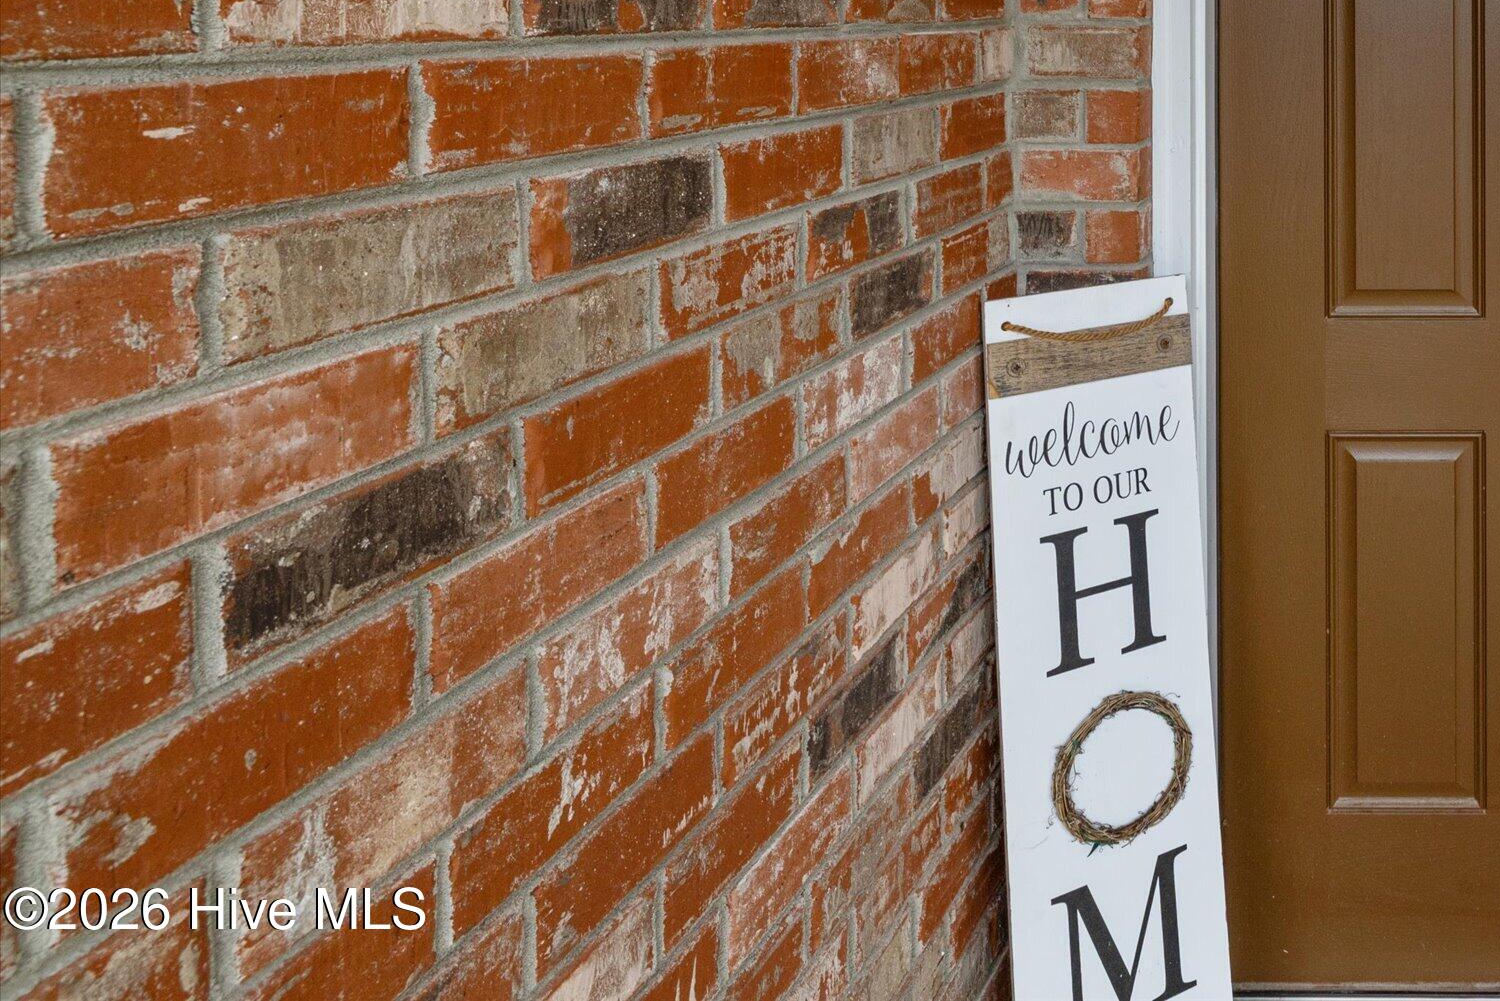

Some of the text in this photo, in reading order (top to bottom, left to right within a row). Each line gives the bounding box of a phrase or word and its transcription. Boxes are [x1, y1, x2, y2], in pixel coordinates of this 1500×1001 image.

[1004, 401, 1182, 479] welcome
[1042, 467, 1152, 516] TO OUR
